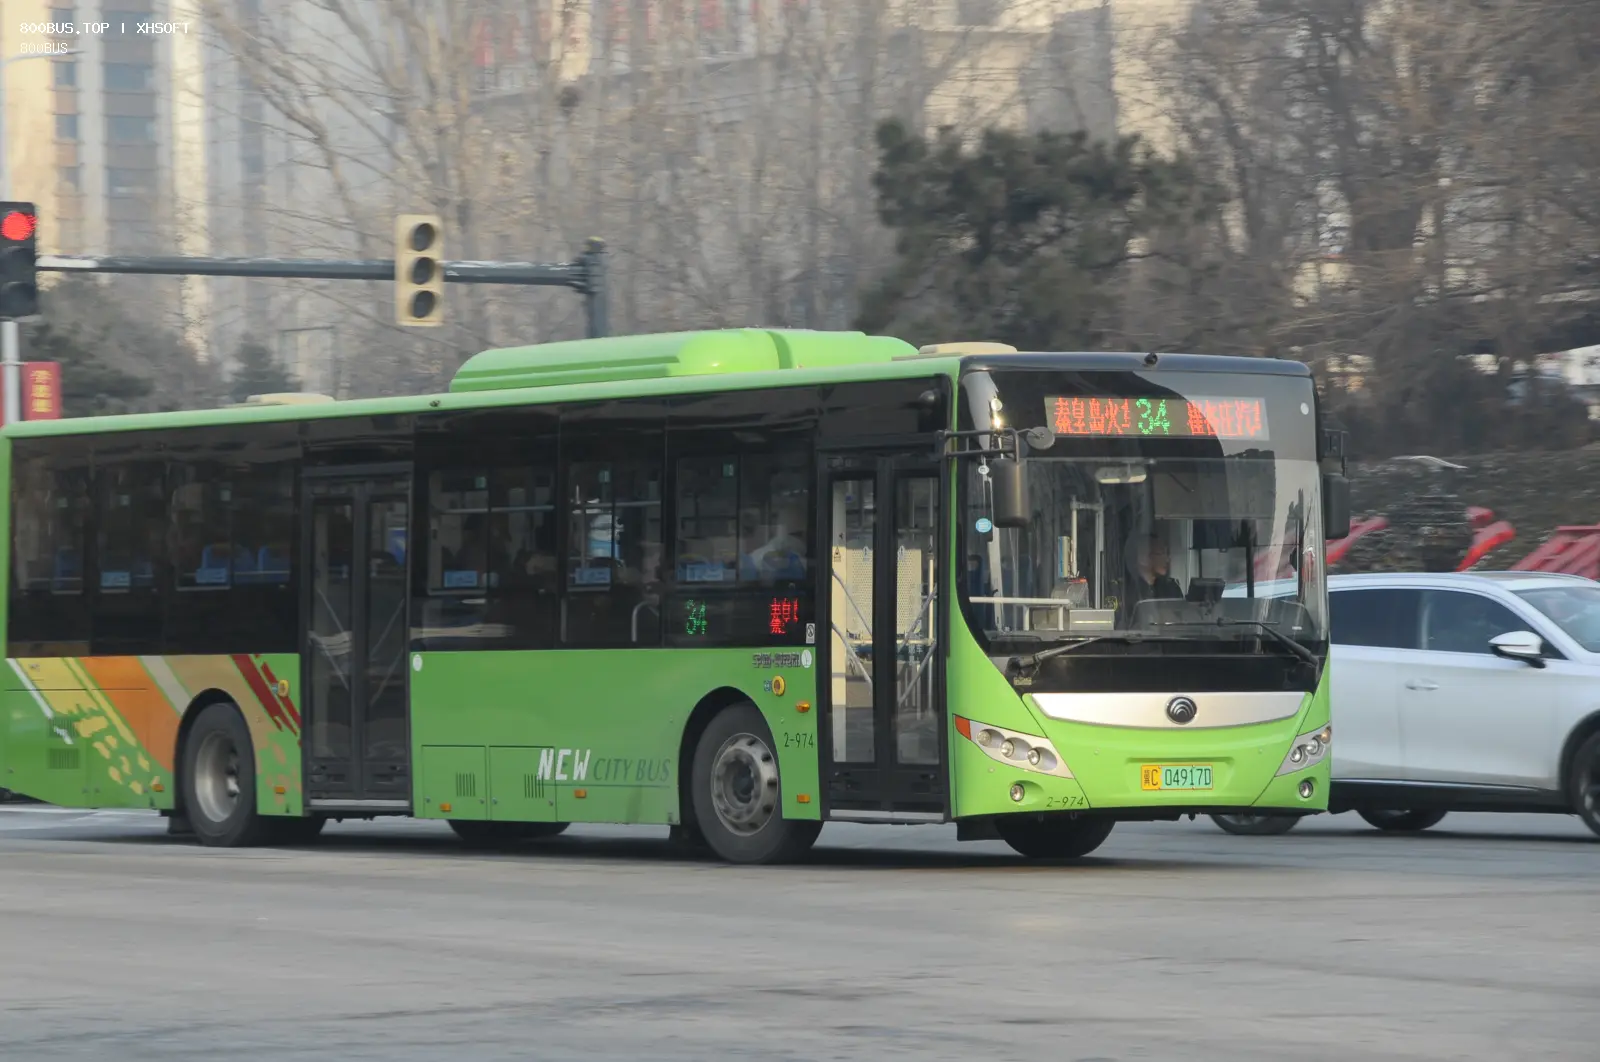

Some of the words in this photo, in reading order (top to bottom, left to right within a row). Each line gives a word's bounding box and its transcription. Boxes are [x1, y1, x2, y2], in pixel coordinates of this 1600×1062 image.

[1136, 398, 1171, 435] 34
[685, 599, 708, 635] 34
[783, 732, 814, 748] 2-974
[536, 748, 591, 781] NEW
[593, 757, 633, 781] CITY
[635, 758, 671, 782] BUS
[1046, 796, 1084, 808] 2-974
